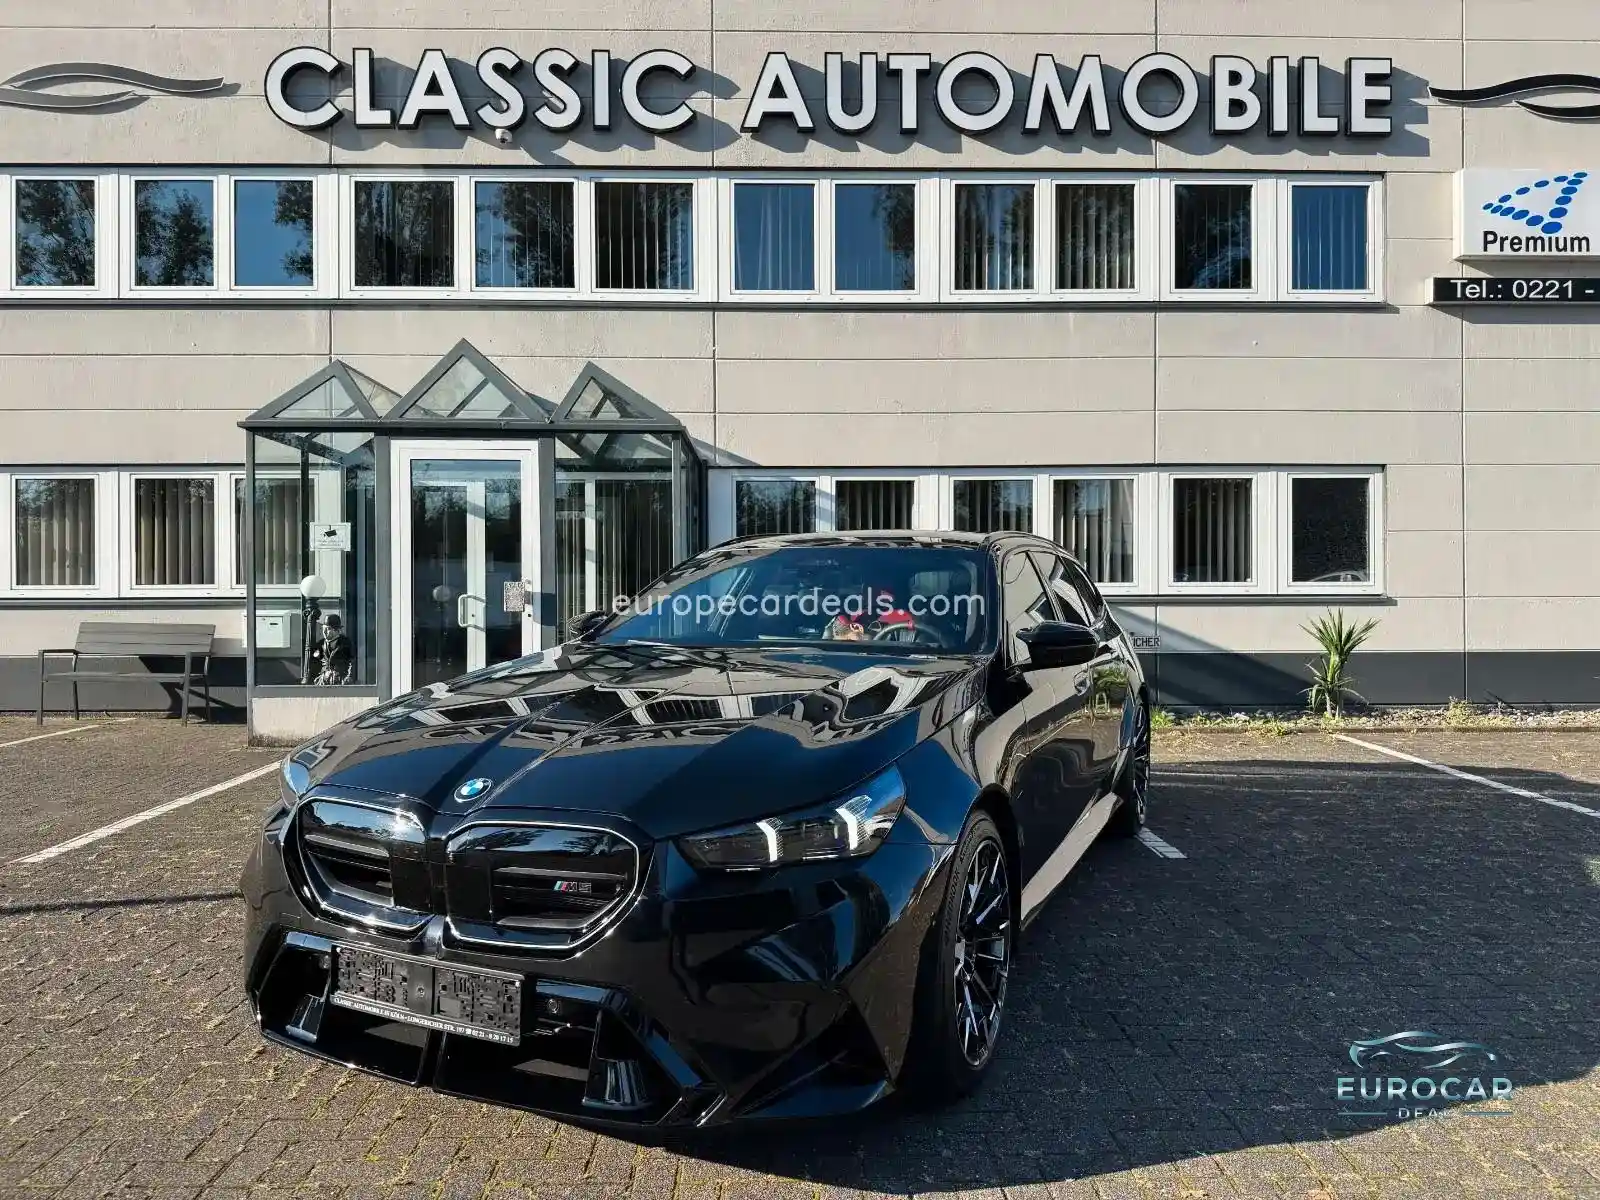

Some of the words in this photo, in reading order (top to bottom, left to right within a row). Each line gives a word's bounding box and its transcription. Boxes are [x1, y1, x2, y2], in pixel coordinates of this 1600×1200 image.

[264, 46, 697, 134] CLASSIC
[741, 51, 1393, 135] AUTOMOBILE
[1482, 230, 1591, 252] Premium
[1450, 279, 1502, 299] Tel.:
[1512, 279, 1574, 299] 0221
